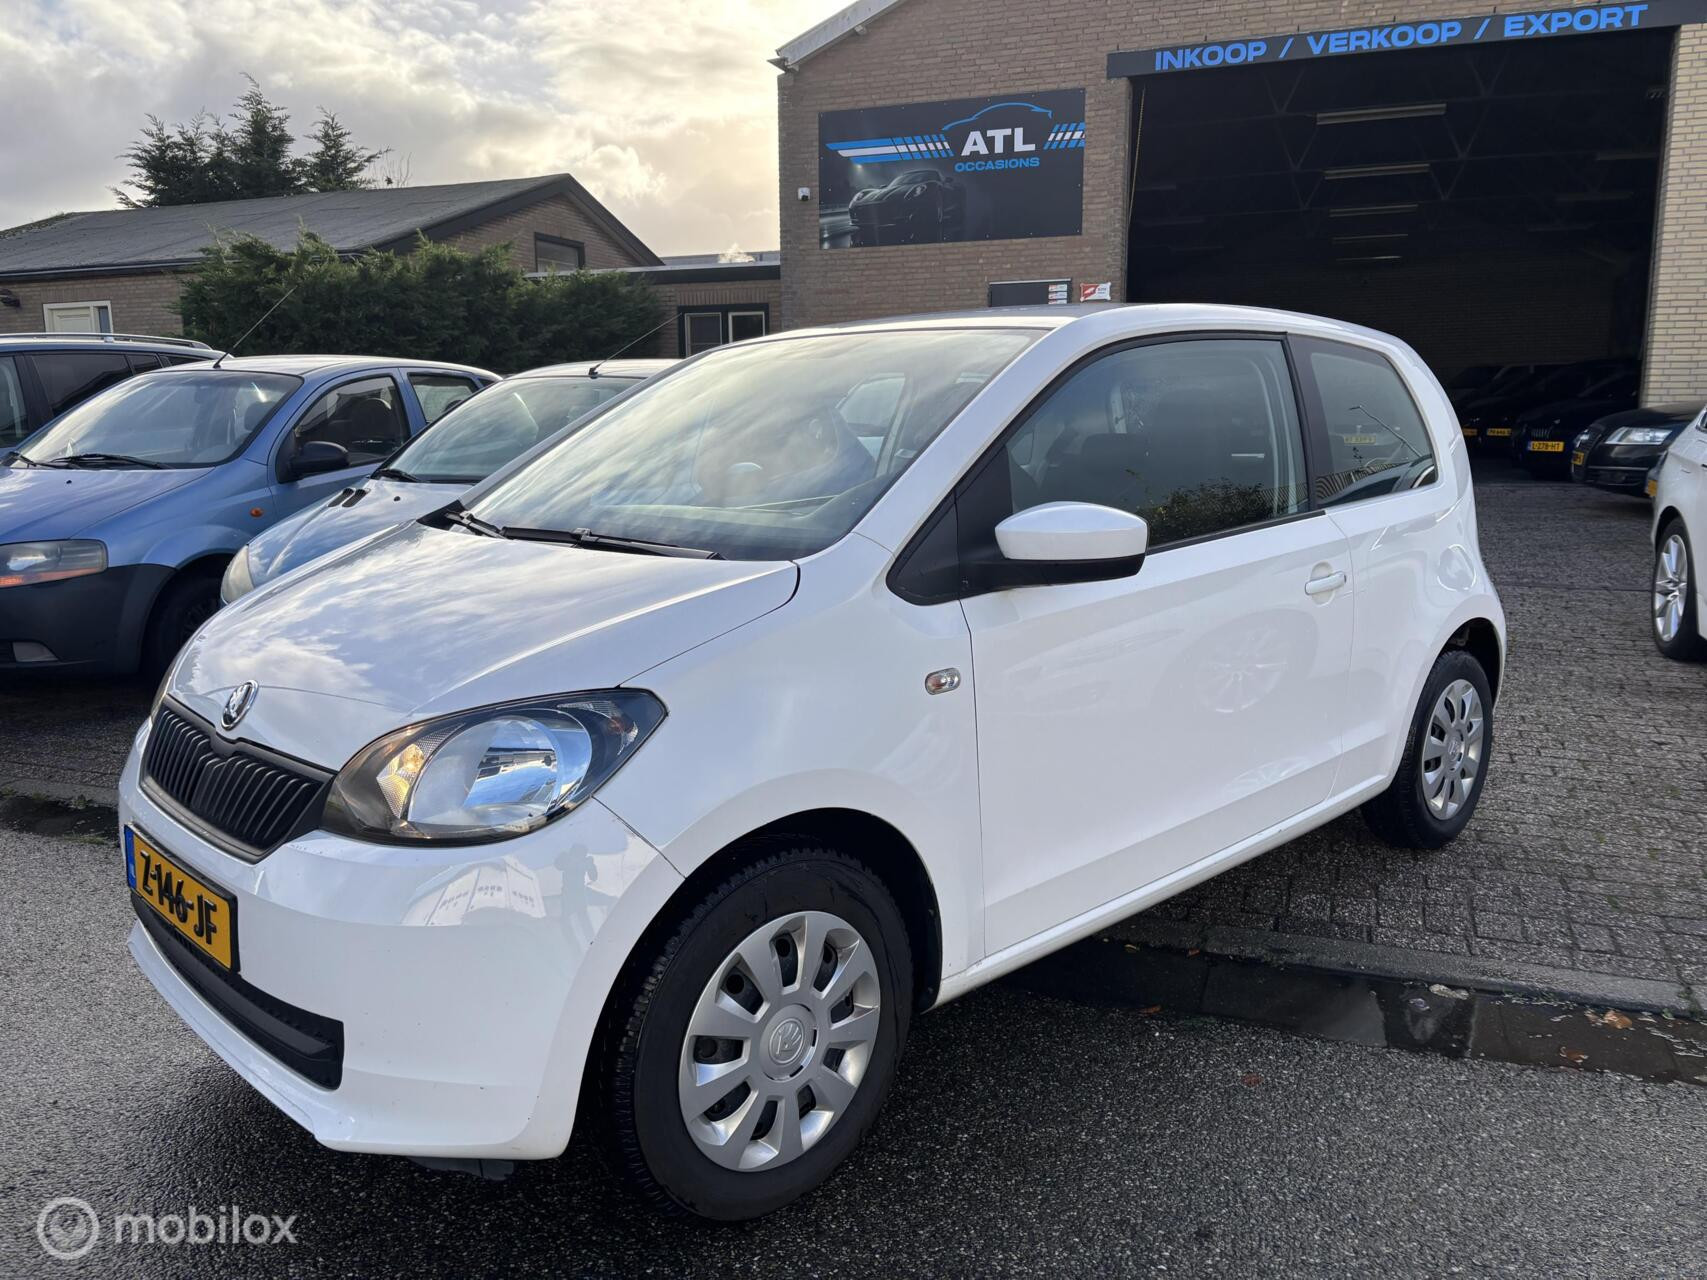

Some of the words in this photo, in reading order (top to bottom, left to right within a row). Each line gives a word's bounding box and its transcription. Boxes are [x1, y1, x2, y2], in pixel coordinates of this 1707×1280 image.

[1155, 42, 1267, 72] INKOOP
[1278, 38, 1293, 59] /
[1306, 21, 1462, 56] VERKOOP
[1474, 18, 1491, 40] /
[1503, 4, 1649, 38] EXPORT
[954, 157, 1041, 173] OCCASIONS
[961, 127, 1036, 157] ATL
[140, 849, 218, 945] Z-146-JF
